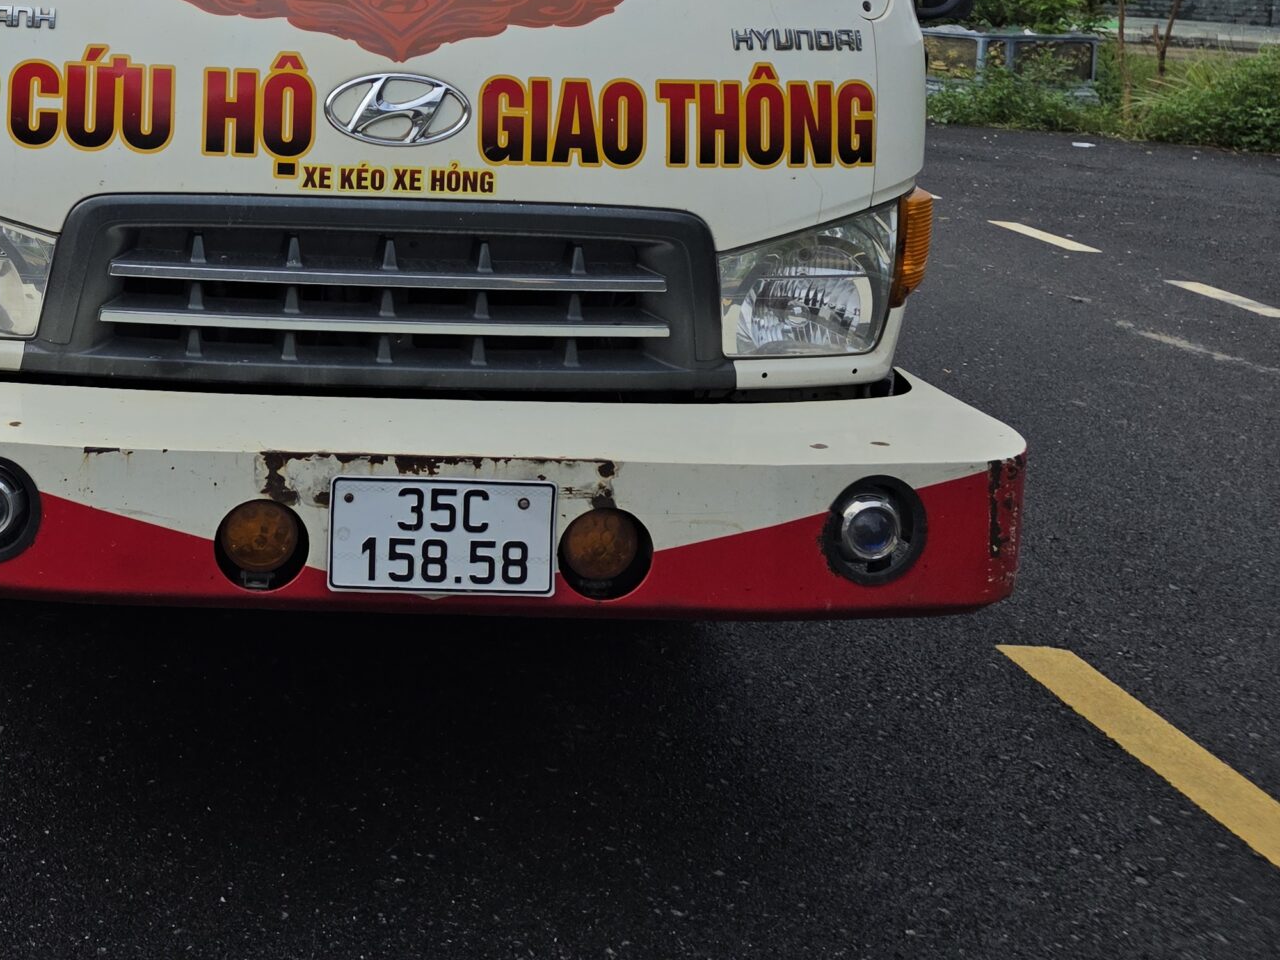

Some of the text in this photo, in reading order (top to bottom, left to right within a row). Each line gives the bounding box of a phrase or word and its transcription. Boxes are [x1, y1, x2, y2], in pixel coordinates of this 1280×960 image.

[731, 28, 863, 52] HYUNDAI
[8, 45, 875, 178] CỨU HỘ GIAO THÔNG
[302, 162, 494, 194] XE KÉO XE HỎNG
[397, 487, 489, 533] 35C
[361, 537, 528, 585] 158.58
